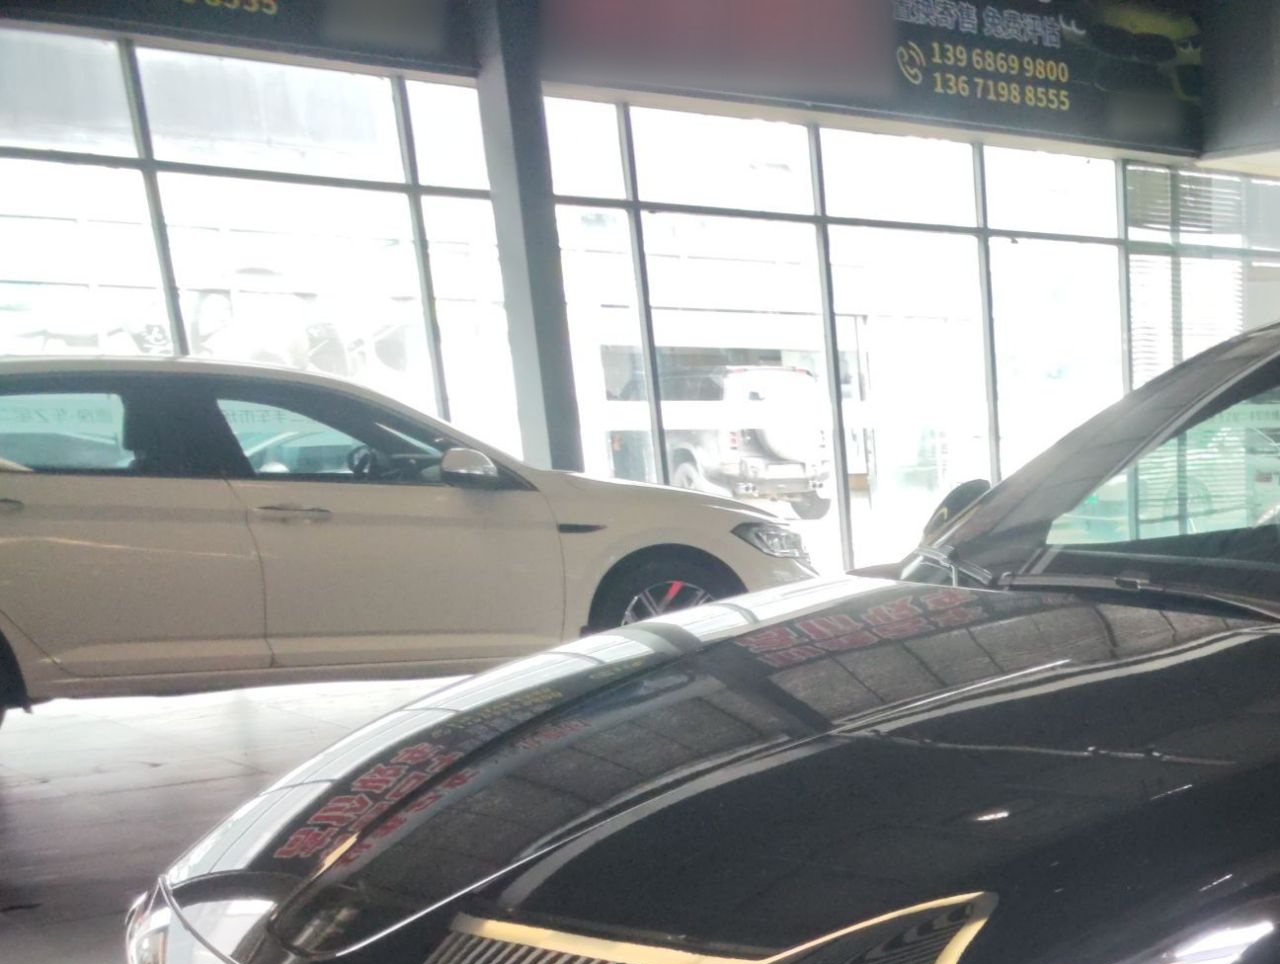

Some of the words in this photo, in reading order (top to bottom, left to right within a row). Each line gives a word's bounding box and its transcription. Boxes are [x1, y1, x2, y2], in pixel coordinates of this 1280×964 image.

[931, 41, 968, 68] 139
[972, 48, 1020, 75] 6869
[1022, 56, 1070, 83] 9800
[933, 71, 970, 98] 136
[973, 77, 1021, 104] 7198
[1024, 85, 1071, 111] 8555
